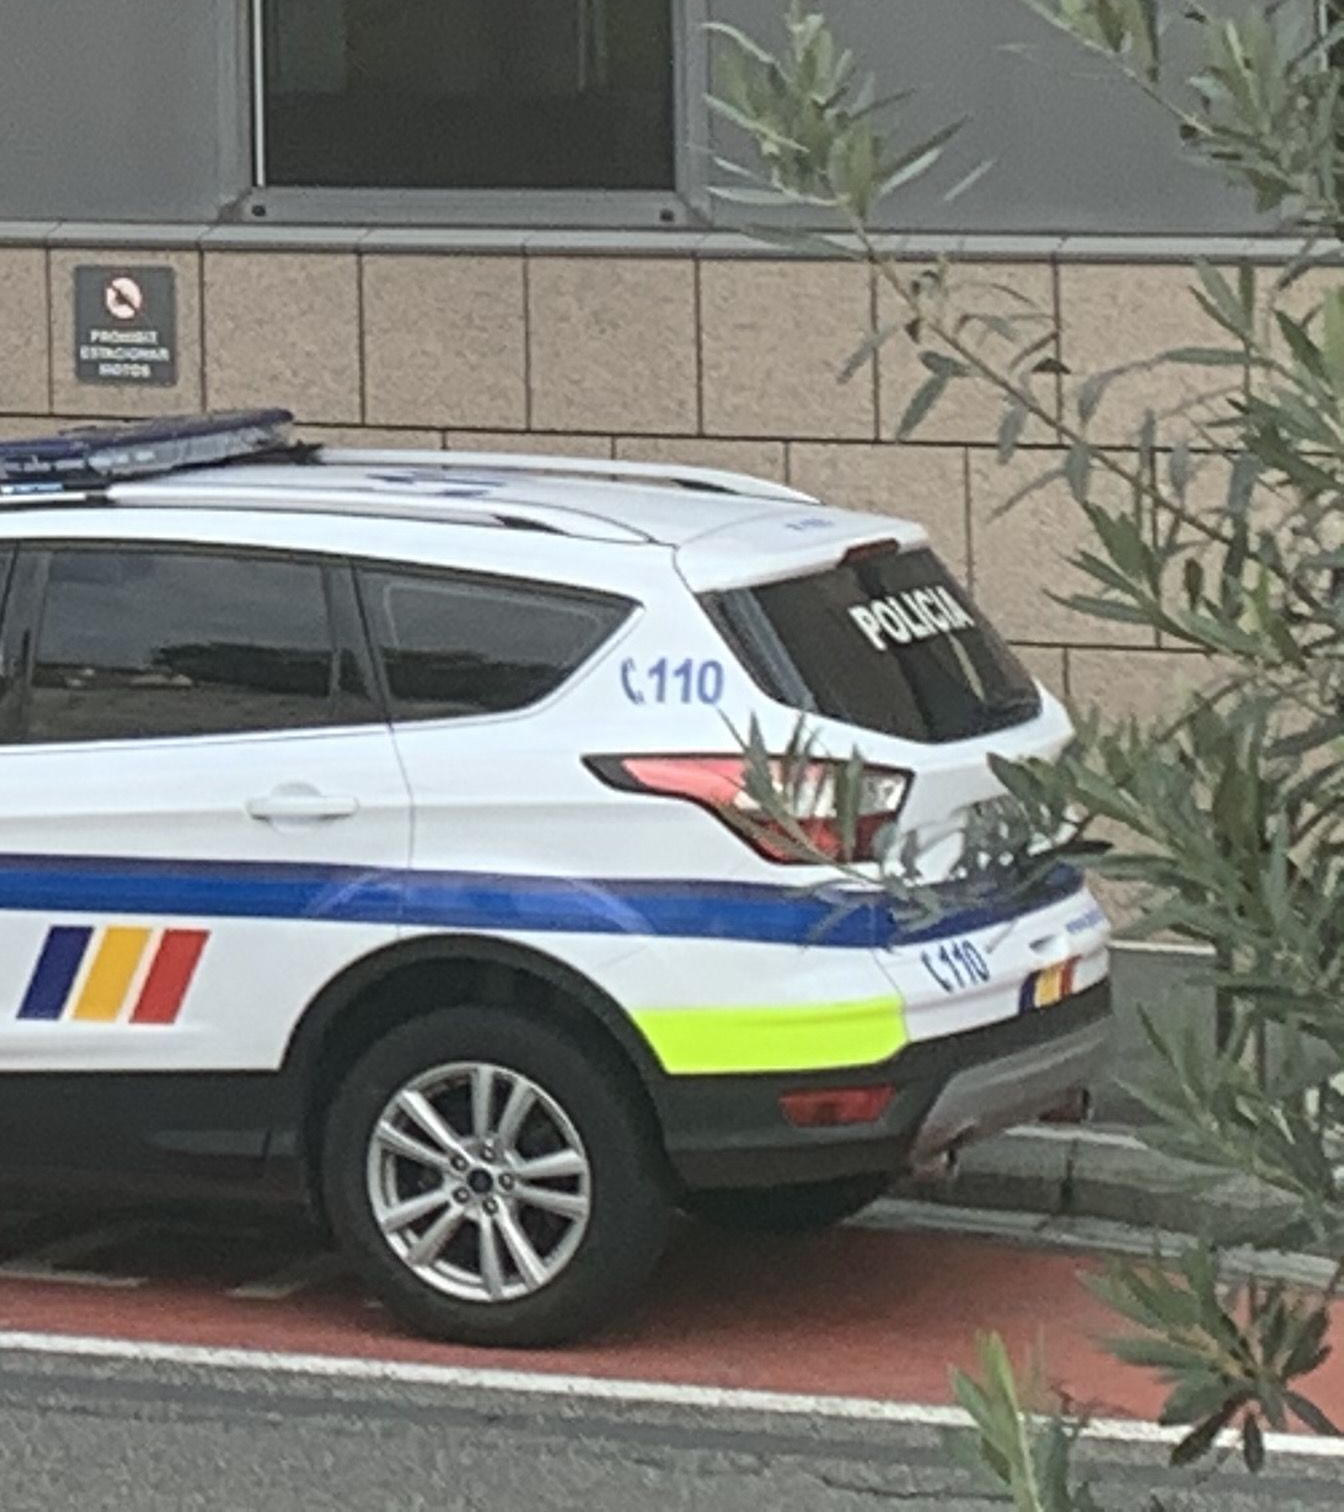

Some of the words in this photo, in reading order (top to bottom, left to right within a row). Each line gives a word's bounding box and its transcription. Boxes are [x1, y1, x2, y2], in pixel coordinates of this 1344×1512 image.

[848, 586, 975, 652] POLICIA
[647, 657, 724, 706] 110
[941, 939, 990, 989] 110
